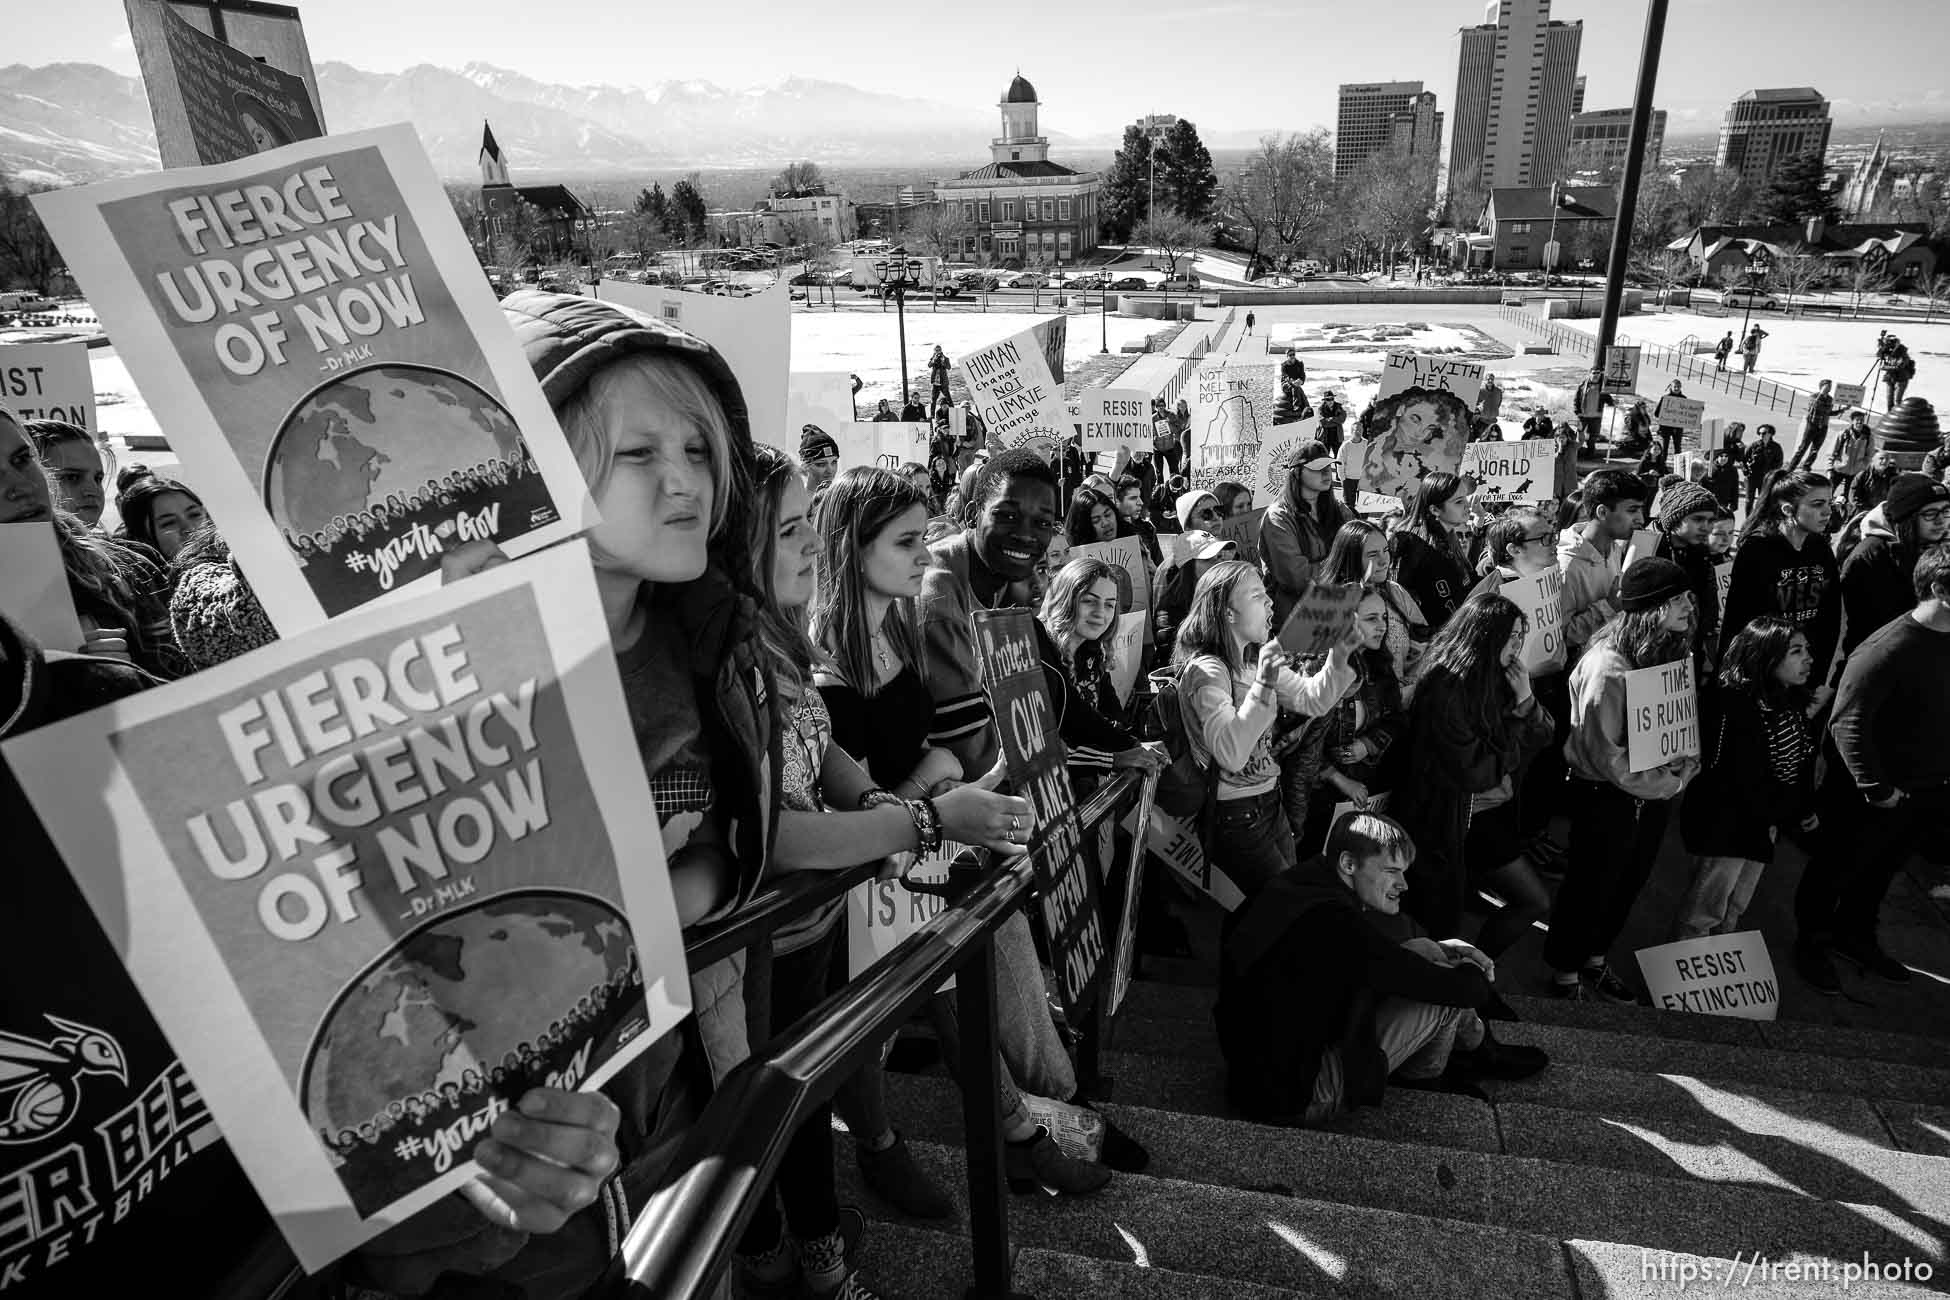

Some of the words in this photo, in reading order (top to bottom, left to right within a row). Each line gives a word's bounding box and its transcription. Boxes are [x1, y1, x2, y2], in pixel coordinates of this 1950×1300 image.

[168, 165, 353, 255] FIERCE
[157, 214, 407, 322] URGENCY
[214, 310, 288, 376] OF
[294, 273, 425, 352] NOW
[345, 343, 373, 364] MLK
[966, 340, 1021, 382] HUMAN
[1200, 371, 1224, 381] NOT
[1413, 374, 1450, 389] HER
[1429, 360, 1483, 379] WITH
[992, 376, 1024, 399] NOT
[1200, 393, 1223, 403] POT
[985, 385, 1048, 425] CLIMATE
[1103, 400, 1143, 417] RESIST
[1087, 422, 1152, 439] EXTINCTION
[1507, 442, 1550, 459] THE
[1194, 468, 1213, 478] WE
[1216, 465, 1252, 477] ASKED
[1479, 459, 1530, 476] WORLD
[1661, 666, 1690, 696] TIME
[217, 623, 480, 785] FIERCE
[1636, 706, 1652, 733] IS
[1661, 725, 1697, 757] OUT!!
[186, 676, 539, 880] URGENCY
[258, 843, 365, 941] OF
[376, 757, 552, 894] NOW
[437, 876, 476, 906] MLK
[867, 880, 896, 928] IS
[1044, 853, 1089, 941] DEPEND
[1066, 940, 1088, 1004] ON
[1675, 950, 1746, 982] RESIST
[1662, 980, 1777, 1014] EXTINCTION
